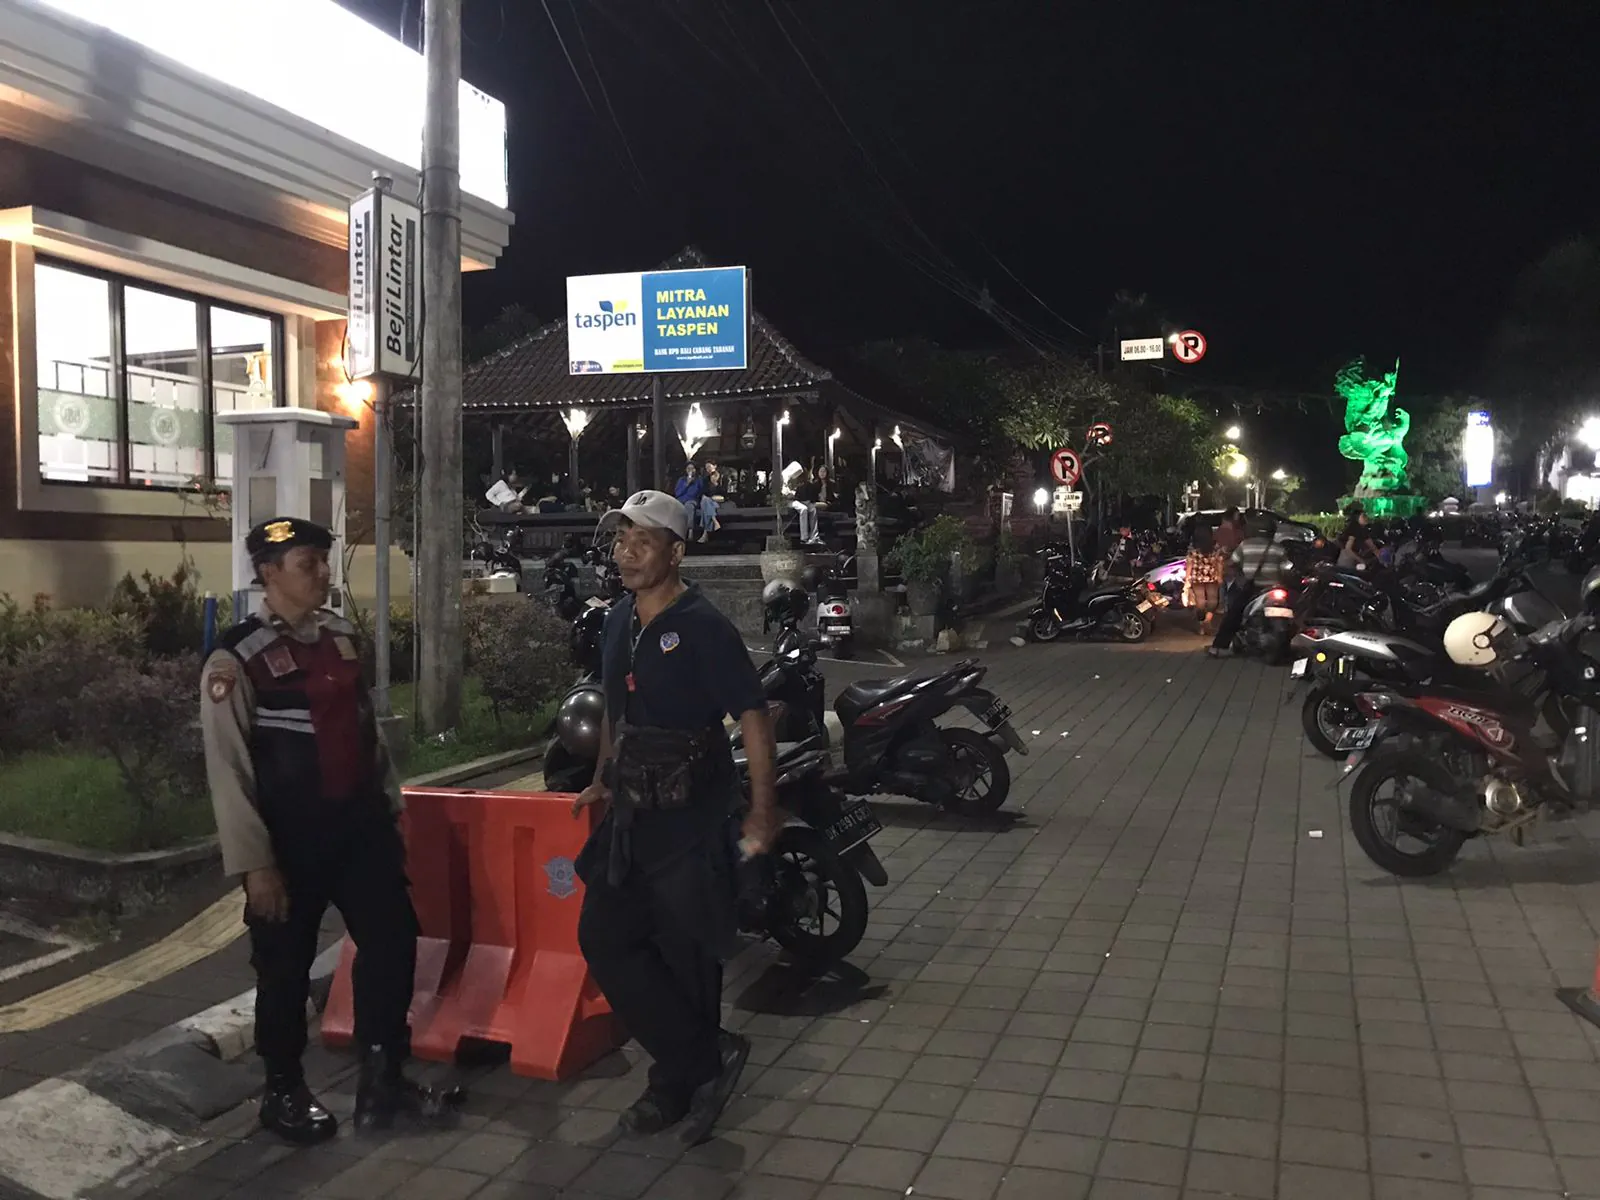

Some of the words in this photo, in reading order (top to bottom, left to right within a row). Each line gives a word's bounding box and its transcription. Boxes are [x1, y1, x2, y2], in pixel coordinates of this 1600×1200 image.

[353, 218, 364, 299] Lintar
[386, 214, 403, 299] Lintar
[656, 288, 706, 304] MITRA
[575, 311, 637, 331] taspen
[656, 304, 730, 321] LAYANAN
[386, 301, 405, 356] Beji
[657, 322, 718, 338] TASPEN
[1124, 346, 1134, 355] JAM
